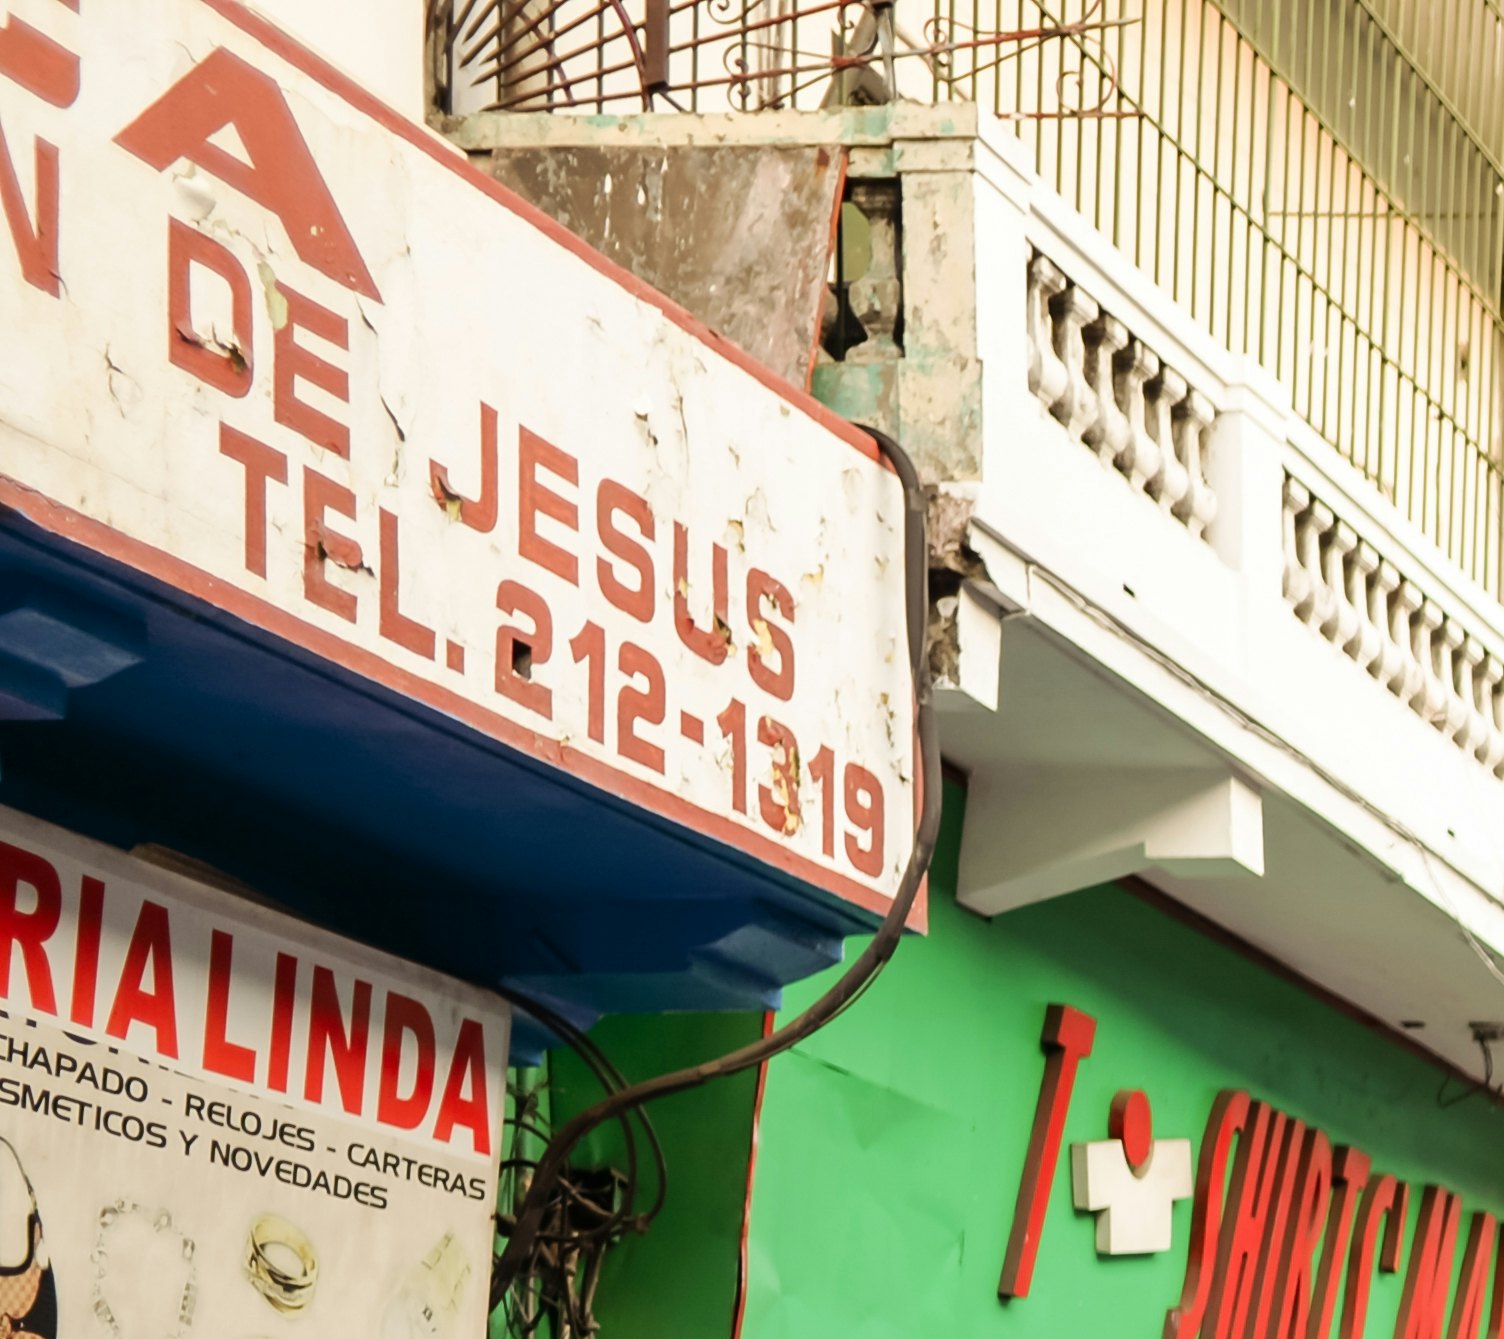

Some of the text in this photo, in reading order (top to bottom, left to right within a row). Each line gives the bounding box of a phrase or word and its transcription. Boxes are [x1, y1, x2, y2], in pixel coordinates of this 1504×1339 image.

[168, 215, 350, 460] DE
[429, 402, 796, 702] JESUS
[219, 422, 885, 878] TEL. 212-1319
[185, 1093, 315, 1151] RELOJES
[347, 1142, 486, 1200] CARTERAS
[202, 929, 491, 1157] LINDA
[179, 1129, 198, 1156] Y
[210, 1139, 388, 1209] NOVEDADES
